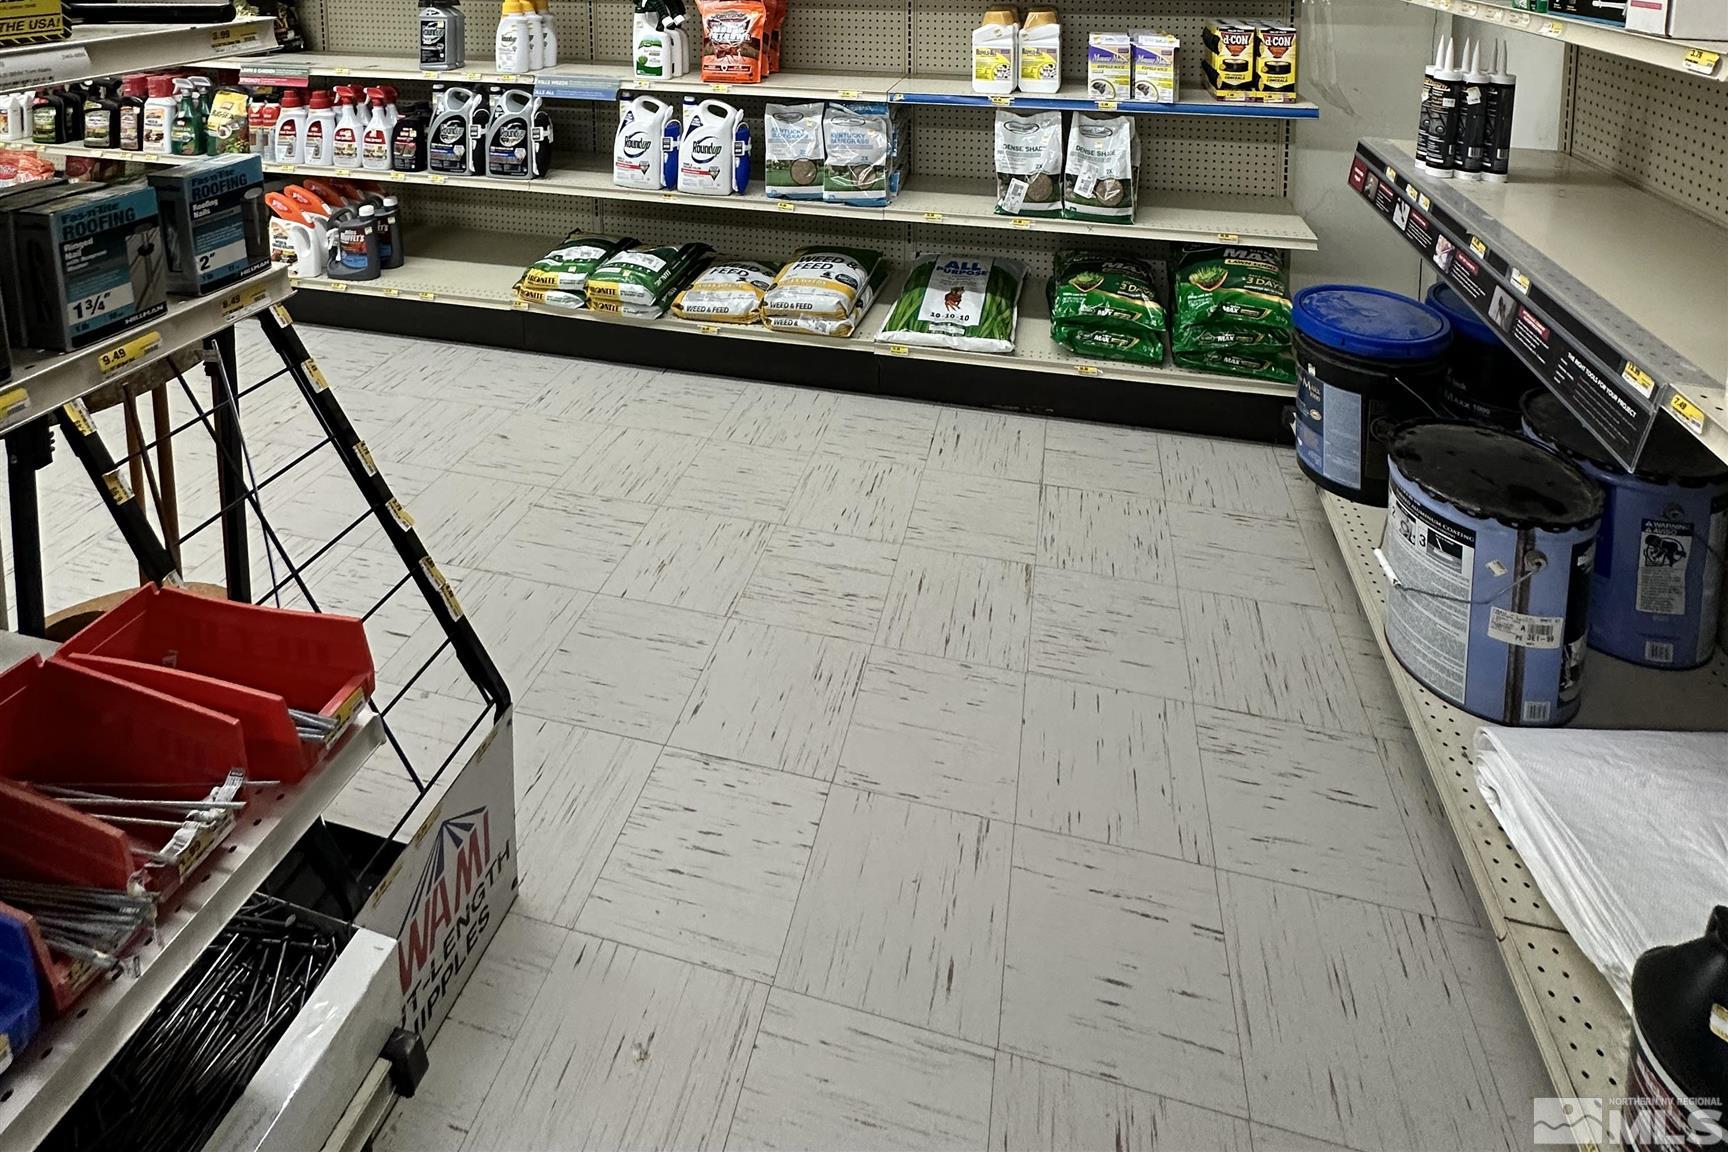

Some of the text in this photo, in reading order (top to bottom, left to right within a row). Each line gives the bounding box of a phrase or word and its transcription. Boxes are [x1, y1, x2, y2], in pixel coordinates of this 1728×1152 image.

[1, 17, 60, 32] THE USA!
[1224, 34, 1248, 45] d-CON
[1265, 36, 1292, 47] d-CON
[624, 134, 651, 150] Roundup
[693, 140, 722, 155] Roundup
[1076, 145, 1095, 156] DENSE
[192, 174, 247, 200] ROOFING
[62, 208, 136, 240] ROOFING
[800, 255, 845, 264] WEED
[1223, 248, 1276, 264] MAX
[793, 262, 833, 271] FEED
[936, 266, 989, 276] PURPOSE
[945, 260, 983, 271] ALL
[709, 267, 749, 277] FEED
[528, 275, 556, 285] IRONITE
[1256, 278, 1284, 290] DAYS
[686, 305, 706, 313] WEED
[712, 306, 730, 314] FEED
[770, 301, 788, 309] WEED
[1223, 305, 1238, 313] MAX
[774, 318, 793, 326] WEED
[102, 349, 126, 366] 9.49
[1616, 398, 1638, 419] PROJECT
[1673, 397, 1687, 410] 7.49
[1654, 521, 1690, 530] WARNING
[1441, 522, 1475, 542] COATING
[1419, 533, 1426, 548] 3
[397, 810, 490, 996] WAMI
